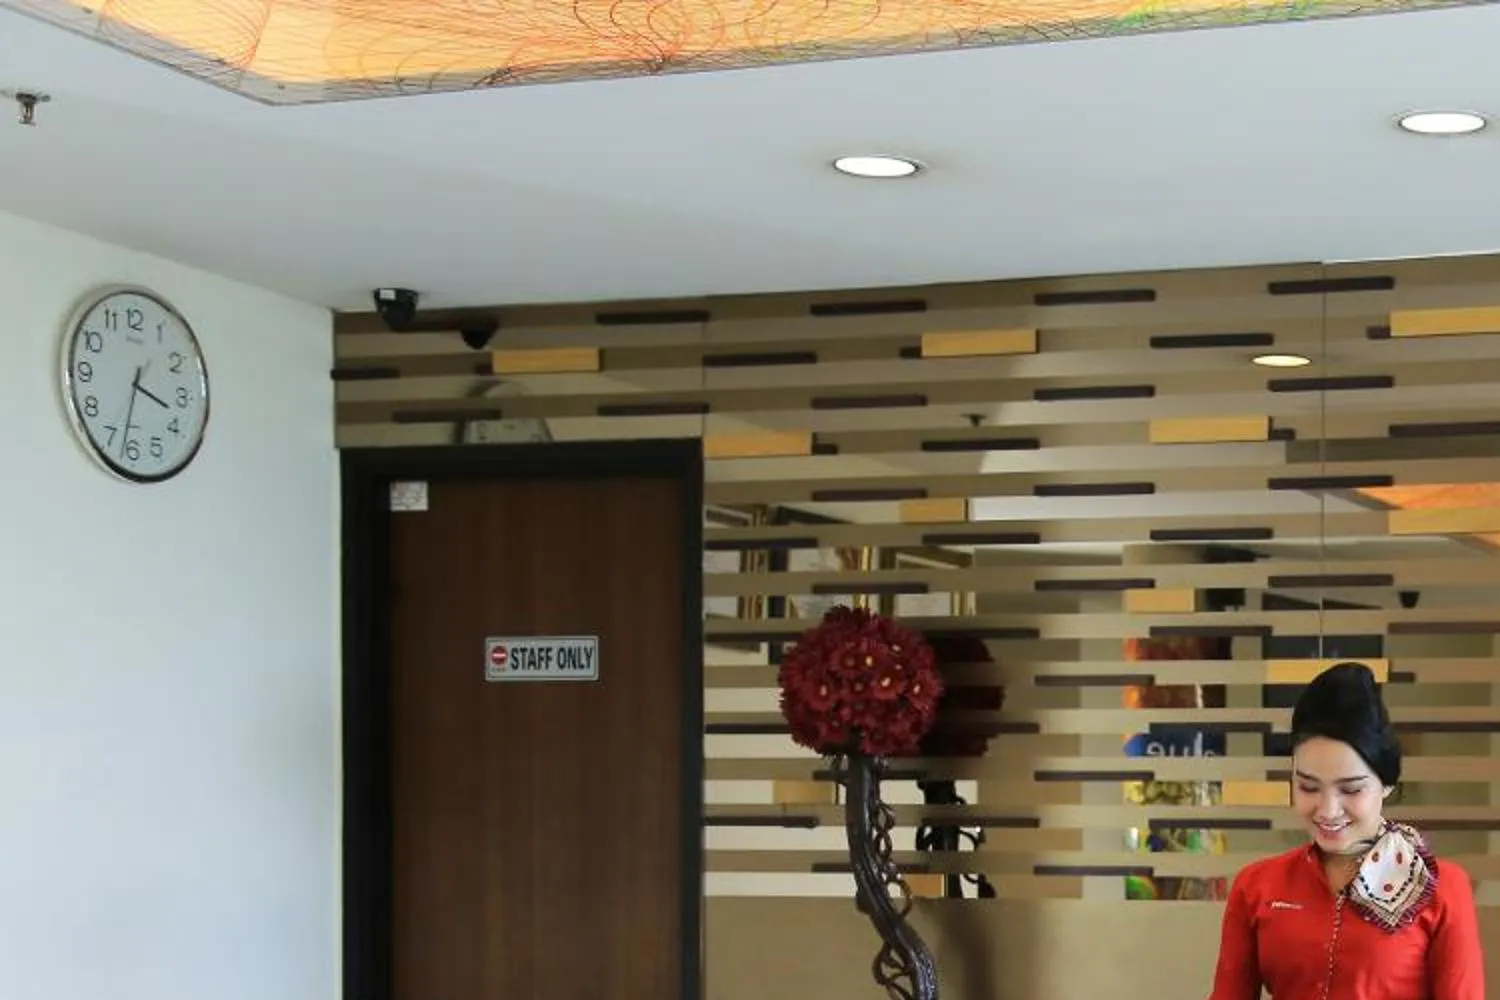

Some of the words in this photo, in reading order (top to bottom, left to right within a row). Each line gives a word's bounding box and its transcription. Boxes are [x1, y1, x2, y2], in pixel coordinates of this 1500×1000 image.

[104, 308, 117, 331] 11
[126, 307, 145, 331] 12
[84, 330, 103, 353] 10
[78, 361, 93, 382] 9
[169, 351, 183, 373] 2
[84, 395, 98, 417] 8
[176, 386, 190, 408] 3
[104, 425, 118, 447] 7
[166, 417, 180, 434] 4
[126, 440, 140, 461] 6
[151, 436, 163, 458] 5
[510, 646, 553, 670] STAFF
[557, 646, 594, 670] ONLY
